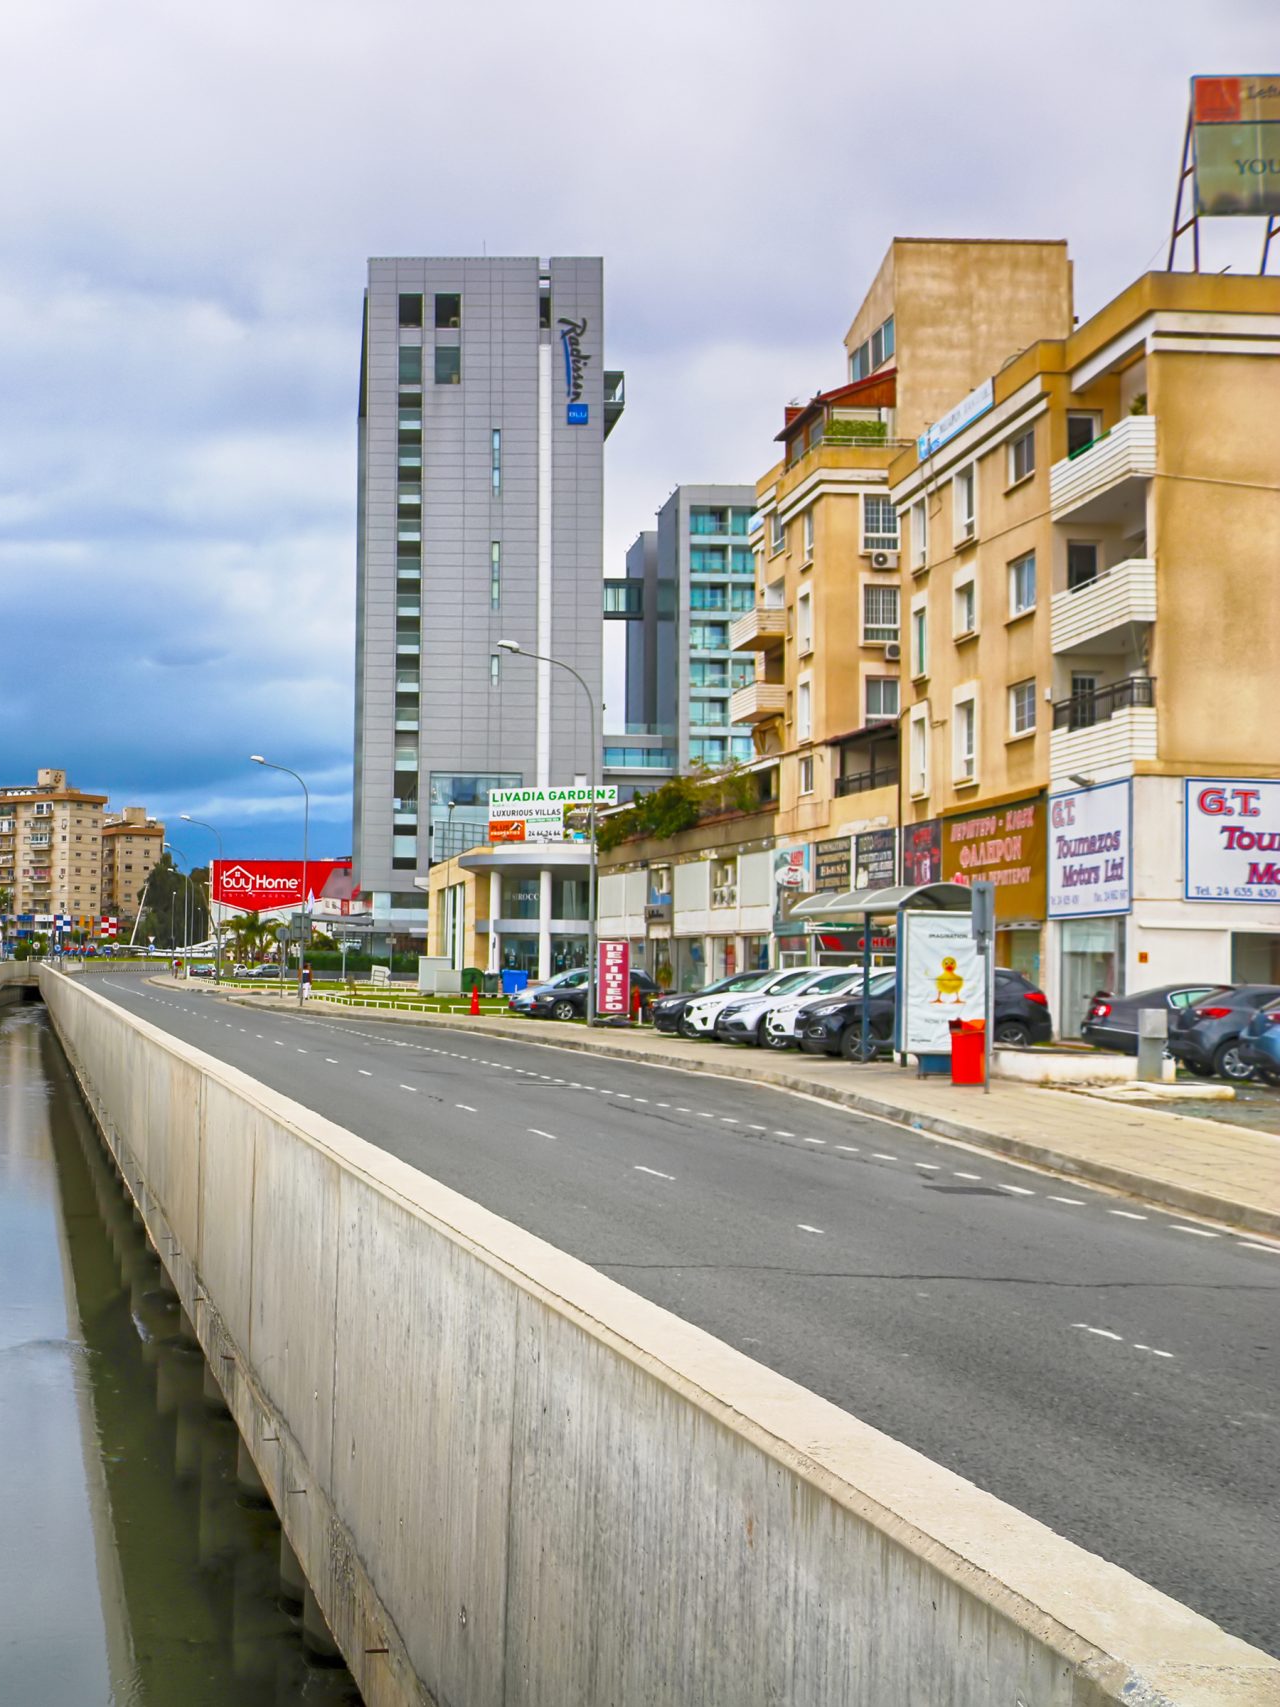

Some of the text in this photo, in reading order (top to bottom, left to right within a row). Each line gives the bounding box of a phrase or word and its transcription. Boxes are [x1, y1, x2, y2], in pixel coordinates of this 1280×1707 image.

[558, 317, 592, 402] Radisson
[492, 789, 616, 802] LIVADIA GARDEN 2
[1197, 788, 1261, 817] G.T.
[492, 809, 534, 817] LUXURIOUS
[1056, 830, 1121, 860] Toumazos
[1062, 857, 1124, 888] Motors Ltd
[1195, 886, 1277, 898] Tel. 24 635 430
[605, 944, 624, 1011] ΠΕΡΙΠΤΕΡΟ
